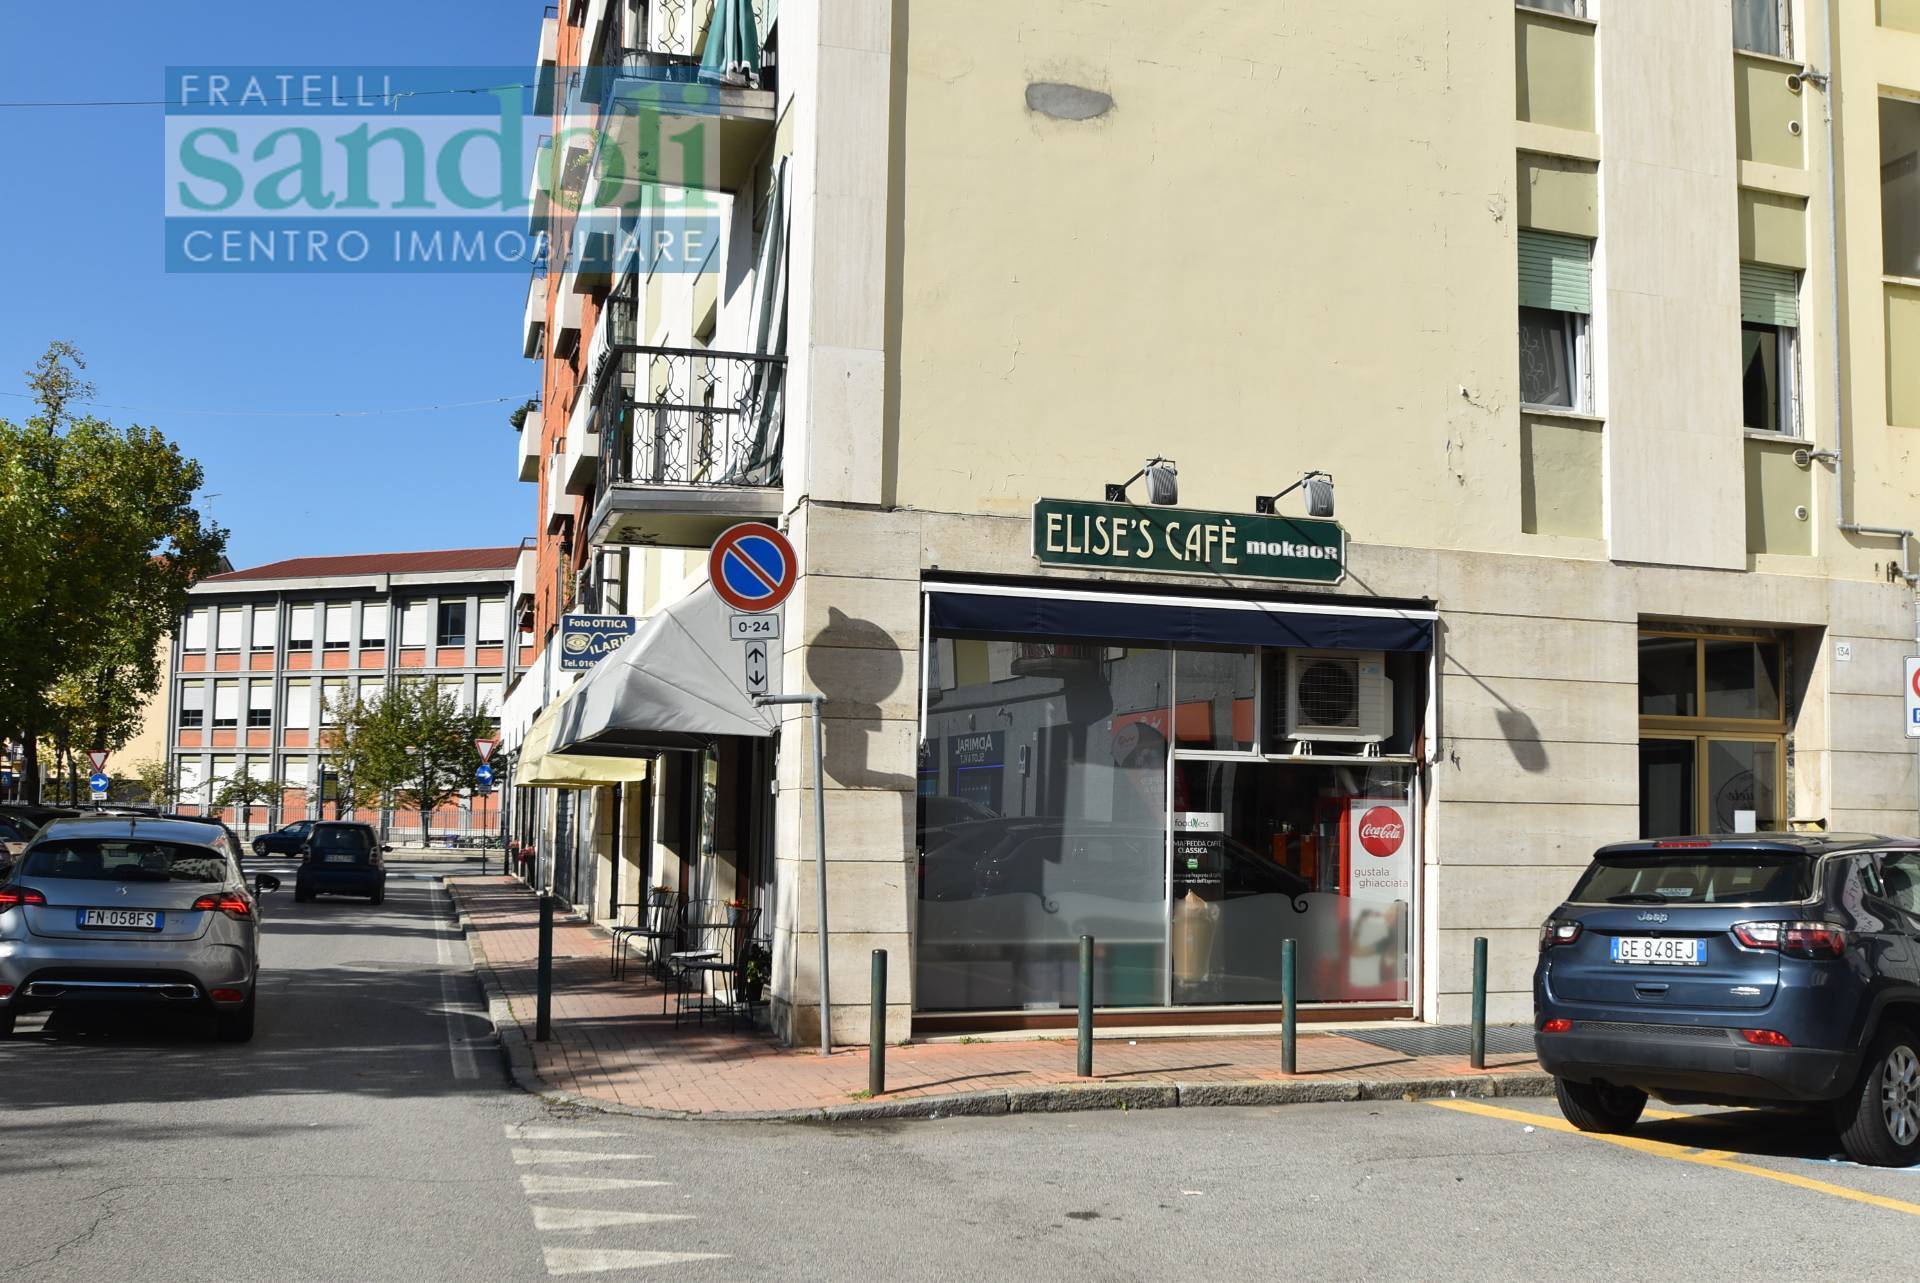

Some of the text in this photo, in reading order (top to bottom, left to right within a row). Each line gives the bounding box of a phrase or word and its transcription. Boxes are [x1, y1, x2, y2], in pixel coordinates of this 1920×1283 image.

[1046, 512, 1154, 559] ELISE'S
[1166, 518, 1238, 565] CAFÈ
[568, 618, 628, 629] Foto OTTICA
[738, 621, 770, 633] 0-24
[563, 659, 578, 667] Tel.
[1354, 867, 1390, 877] gustala
[1358, 877, 1409, 889] ghiacciata
[87, 910, 105, 924] FN
[110, 911, 155, 926] 058FS
[1637, 912, 1668, 923] Jeep
[1621, 940, 1639, 958] GE
[1644, 940, 1695, 960] 848EJ
